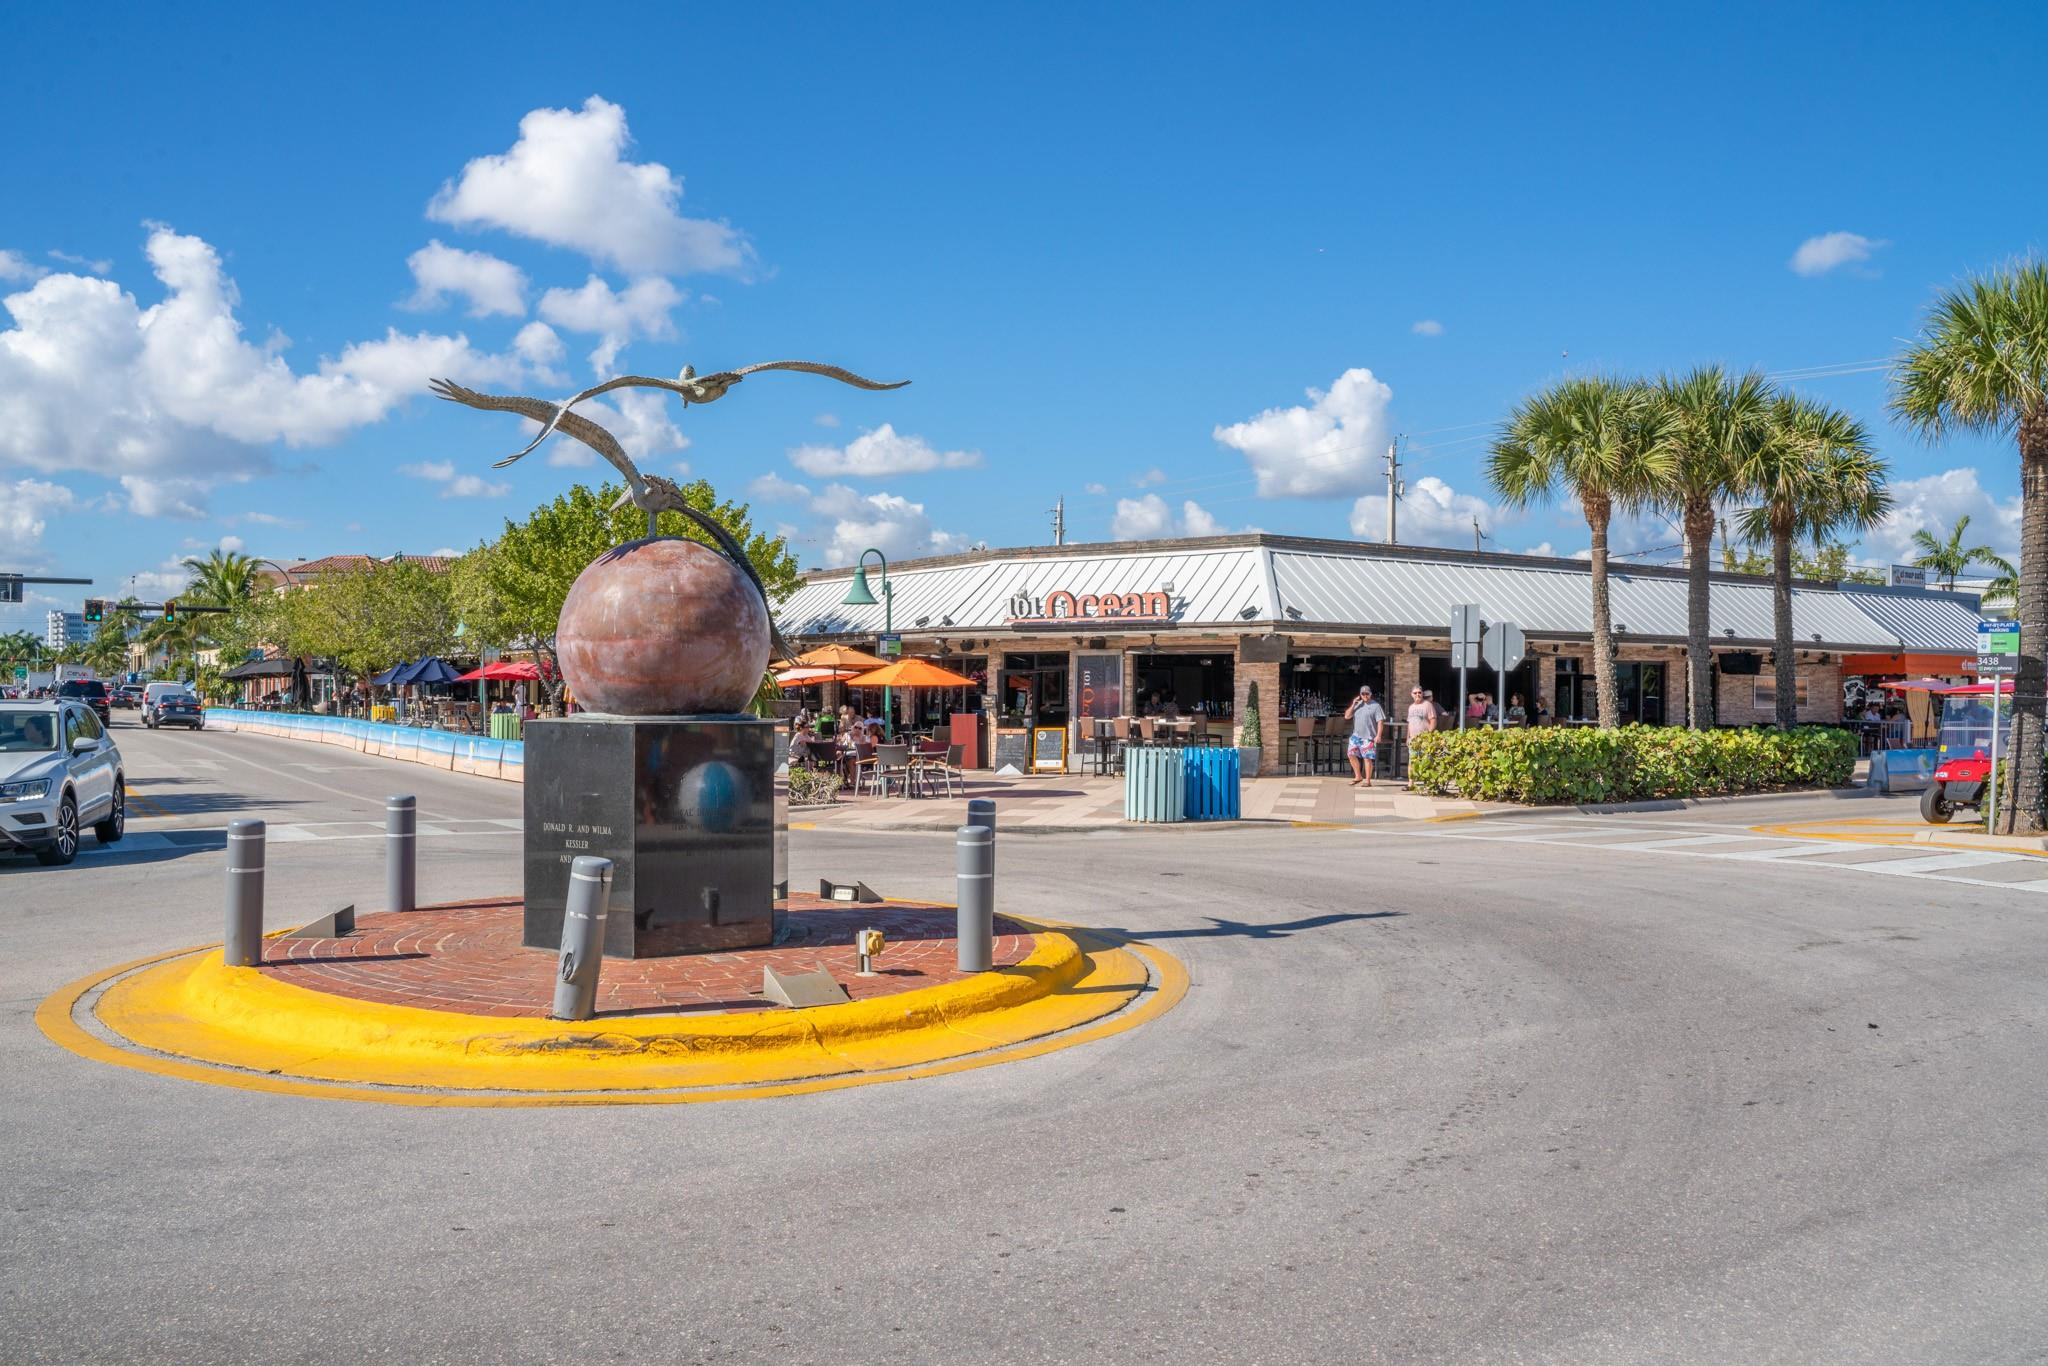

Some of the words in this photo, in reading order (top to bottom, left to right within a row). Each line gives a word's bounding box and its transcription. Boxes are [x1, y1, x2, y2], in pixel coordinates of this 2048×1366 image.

[1045, 590, 1170, 618] Ocean
[1977, 656, 1999, 666] 3438
[1083, 670, 1091, 686] 101
[543, 822, 566, 832] DONALD
[577, 824, 590, 834] AND
[592, 825, 612, 836] WILMA
[565, 839, 589, 849] KESSLER
[559, 854, 572, 864] AND
